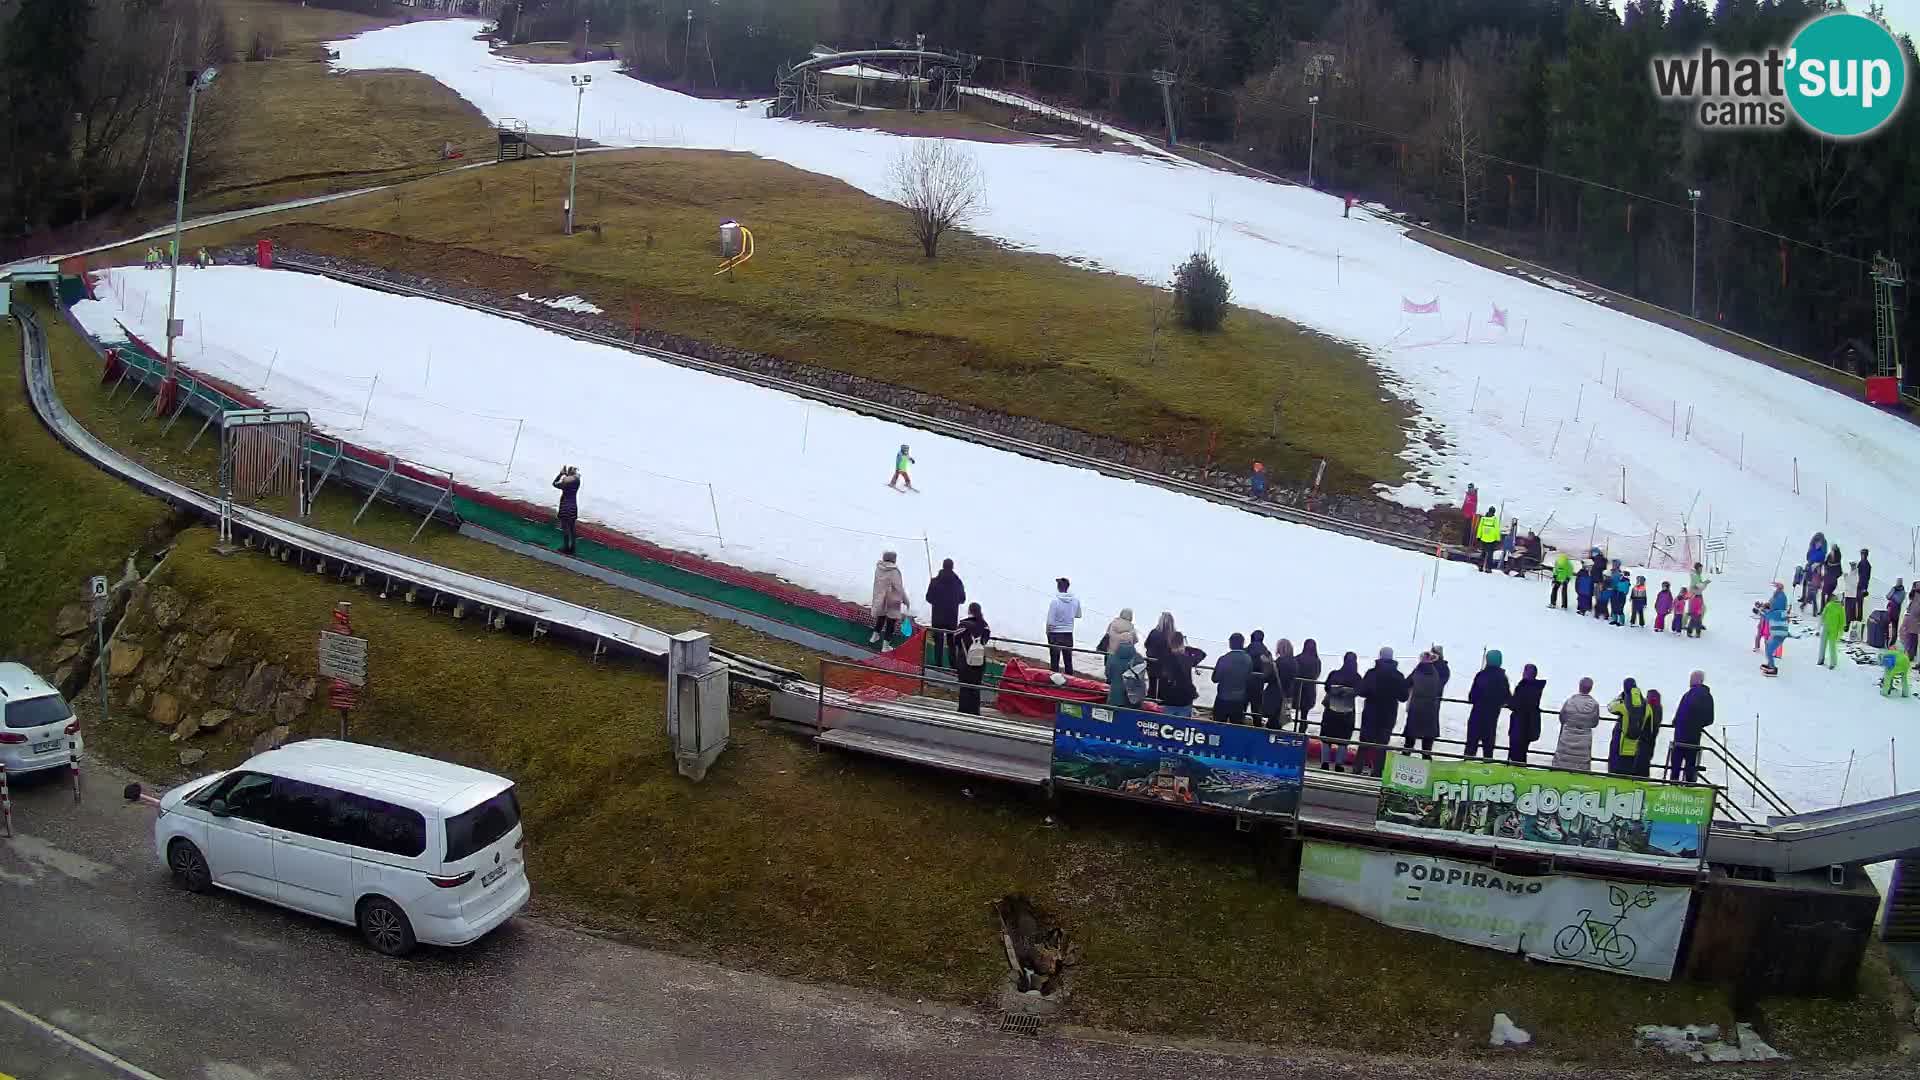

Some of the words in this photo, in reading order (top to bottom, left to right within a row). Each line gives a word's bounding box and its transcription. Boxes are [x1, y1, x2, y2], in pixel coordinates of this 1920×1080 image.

[1160, 724, 1206, 746] Celje
[1432, 779, 1470, 802] Pri
[1473, 782, 1515, 803] nas
[1394, 861, 1543, 895] PODPIRAMO
